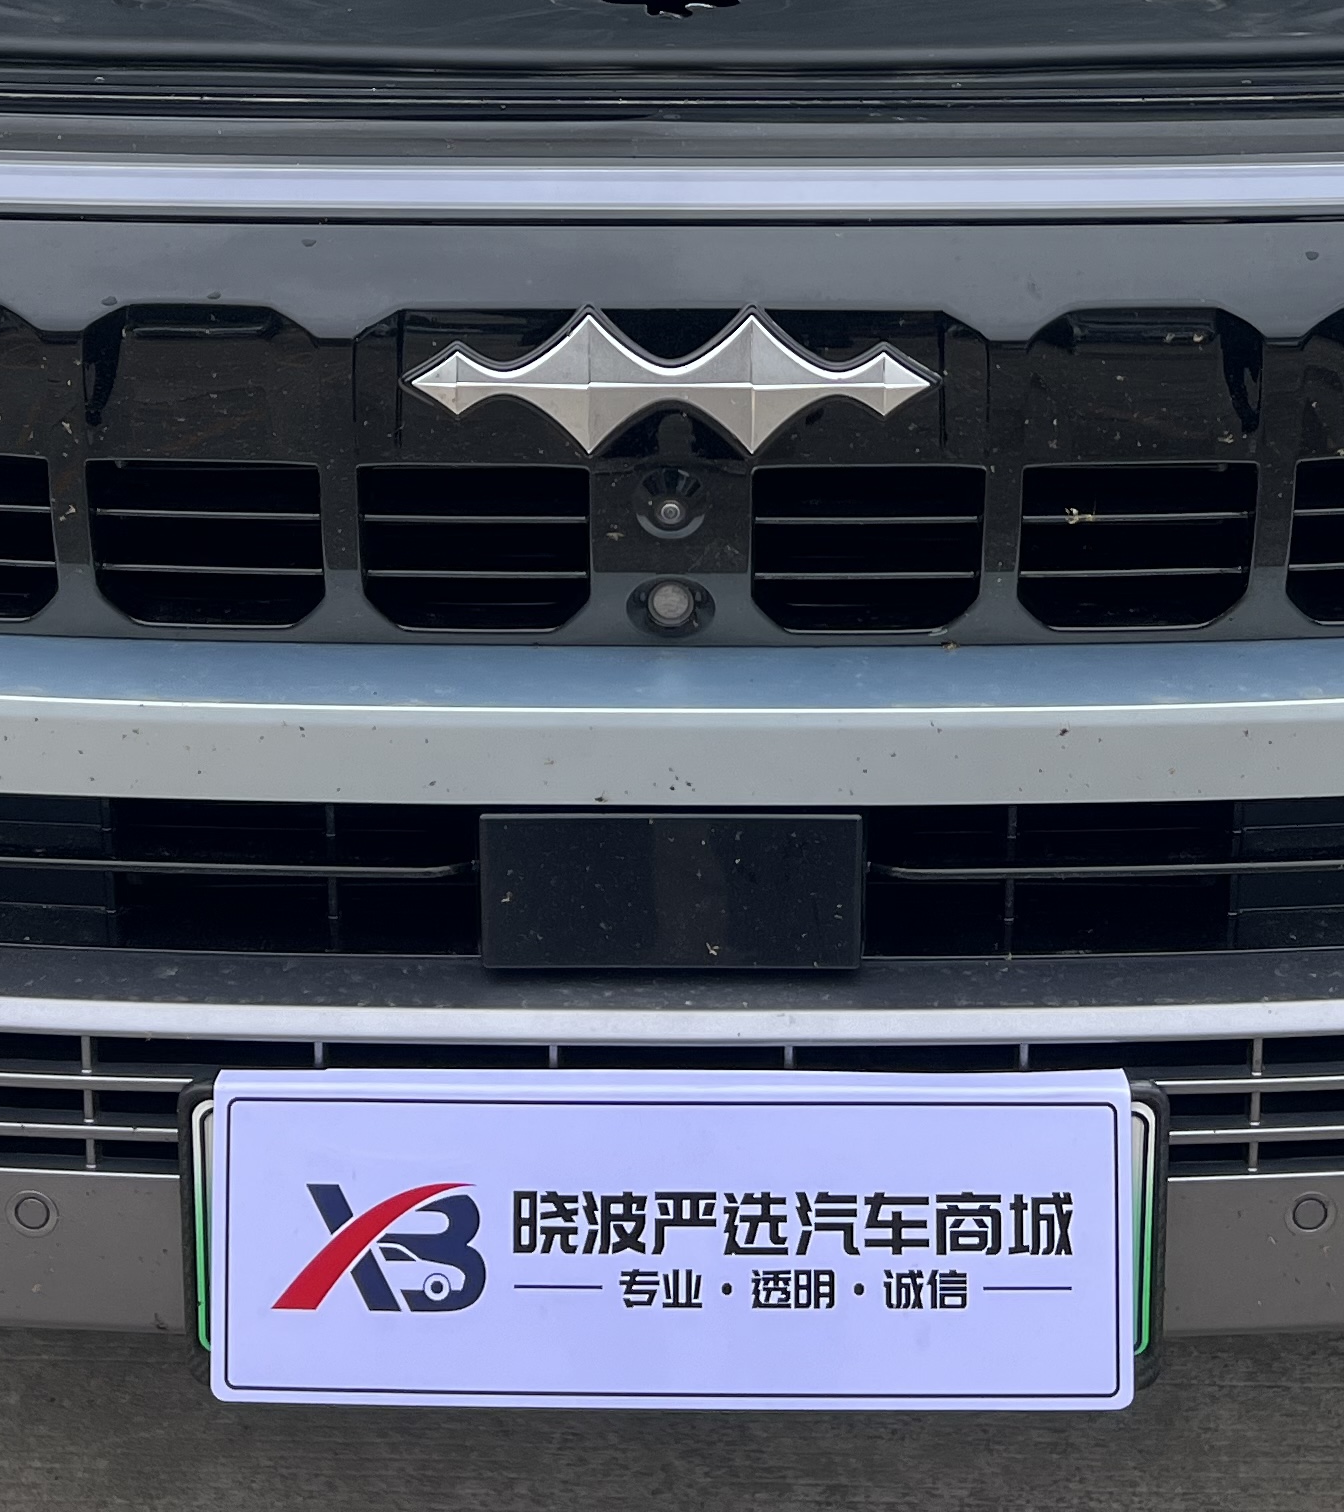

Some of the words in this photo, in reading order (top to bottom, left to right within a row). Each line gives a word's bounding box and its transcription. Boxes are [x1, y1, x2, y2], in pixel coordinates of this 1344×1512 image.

[513, 1190, 1073, 1256] 晓波严选汽车商城
